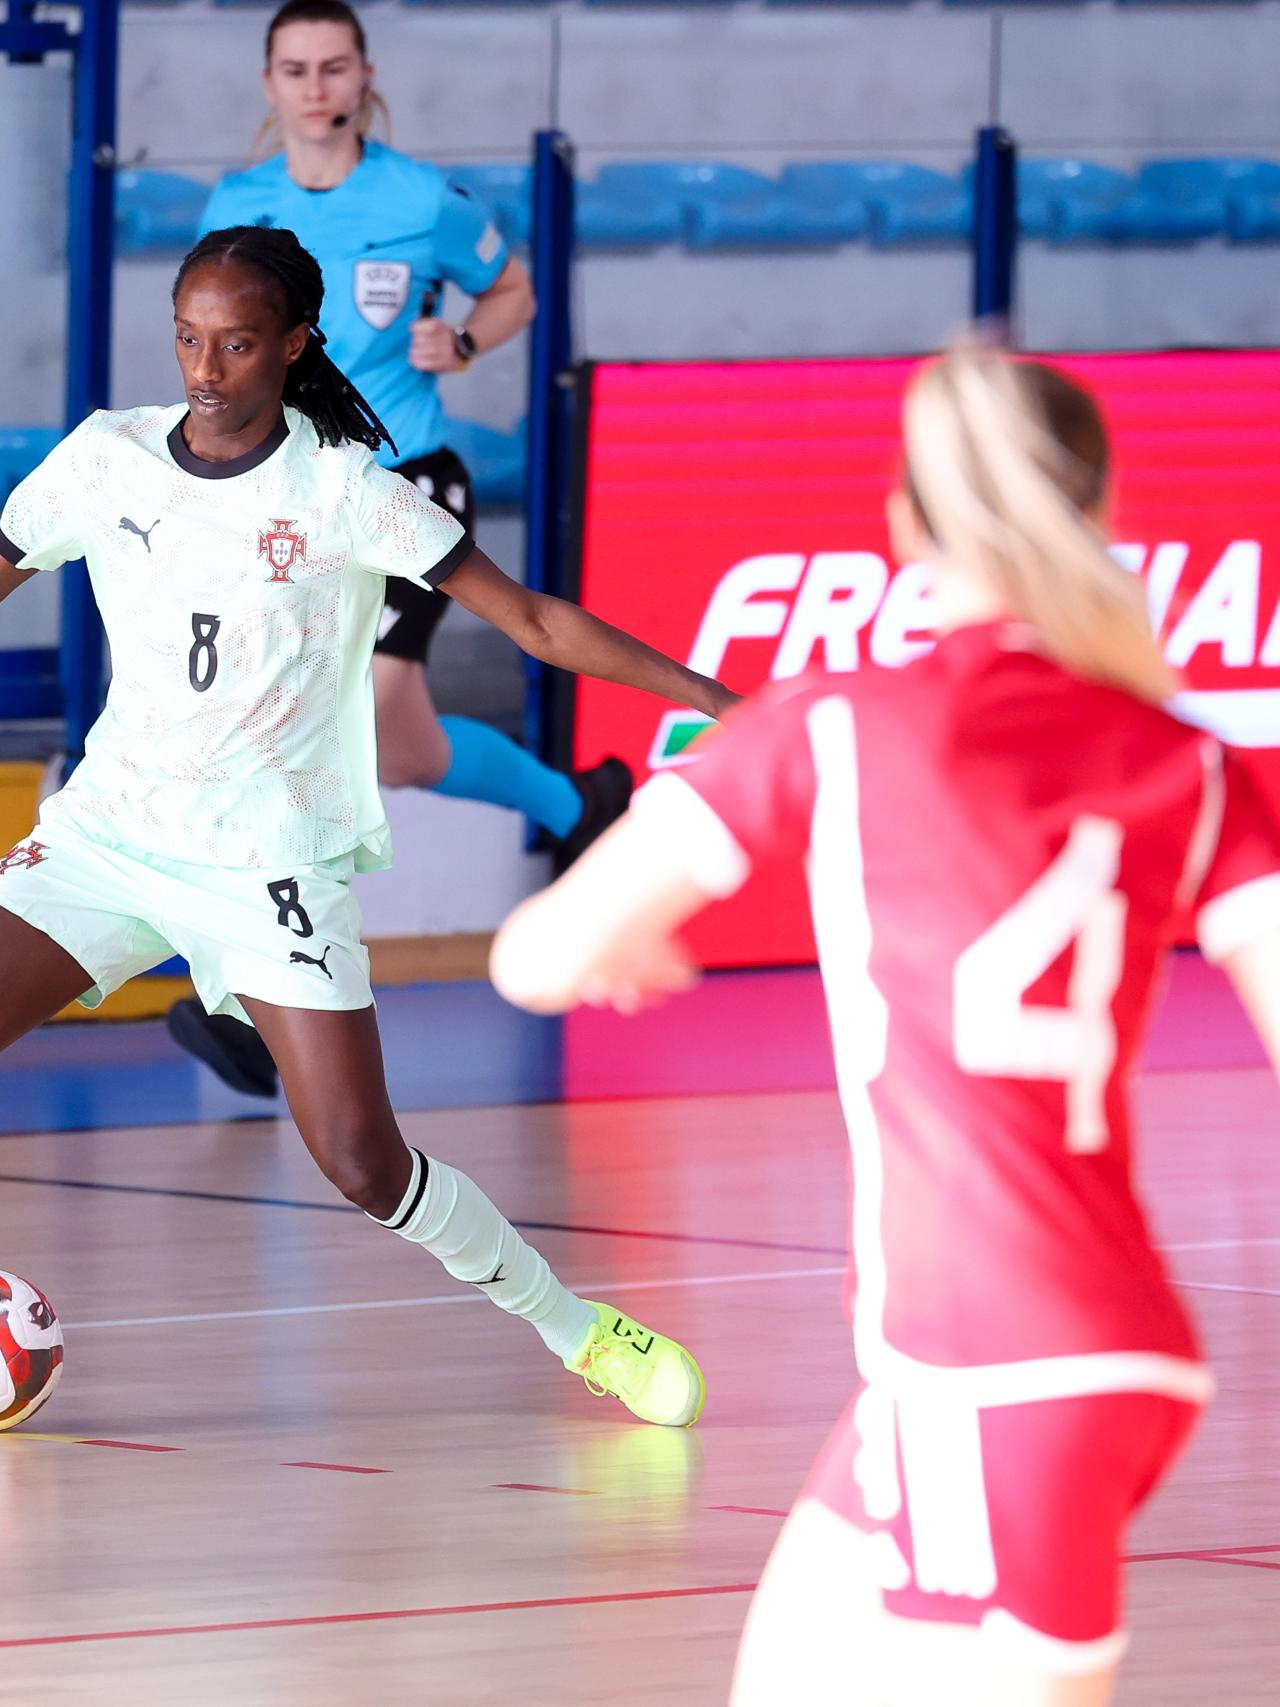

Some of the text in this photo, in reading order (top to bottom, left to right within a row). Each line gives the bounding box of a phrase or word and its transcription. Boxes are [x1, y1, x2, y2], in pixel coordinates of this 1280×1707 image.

[188, 612, 221, 693] 8
[267, 876, 315, 938] 8
[952, 812, 1128, 1154] 4
